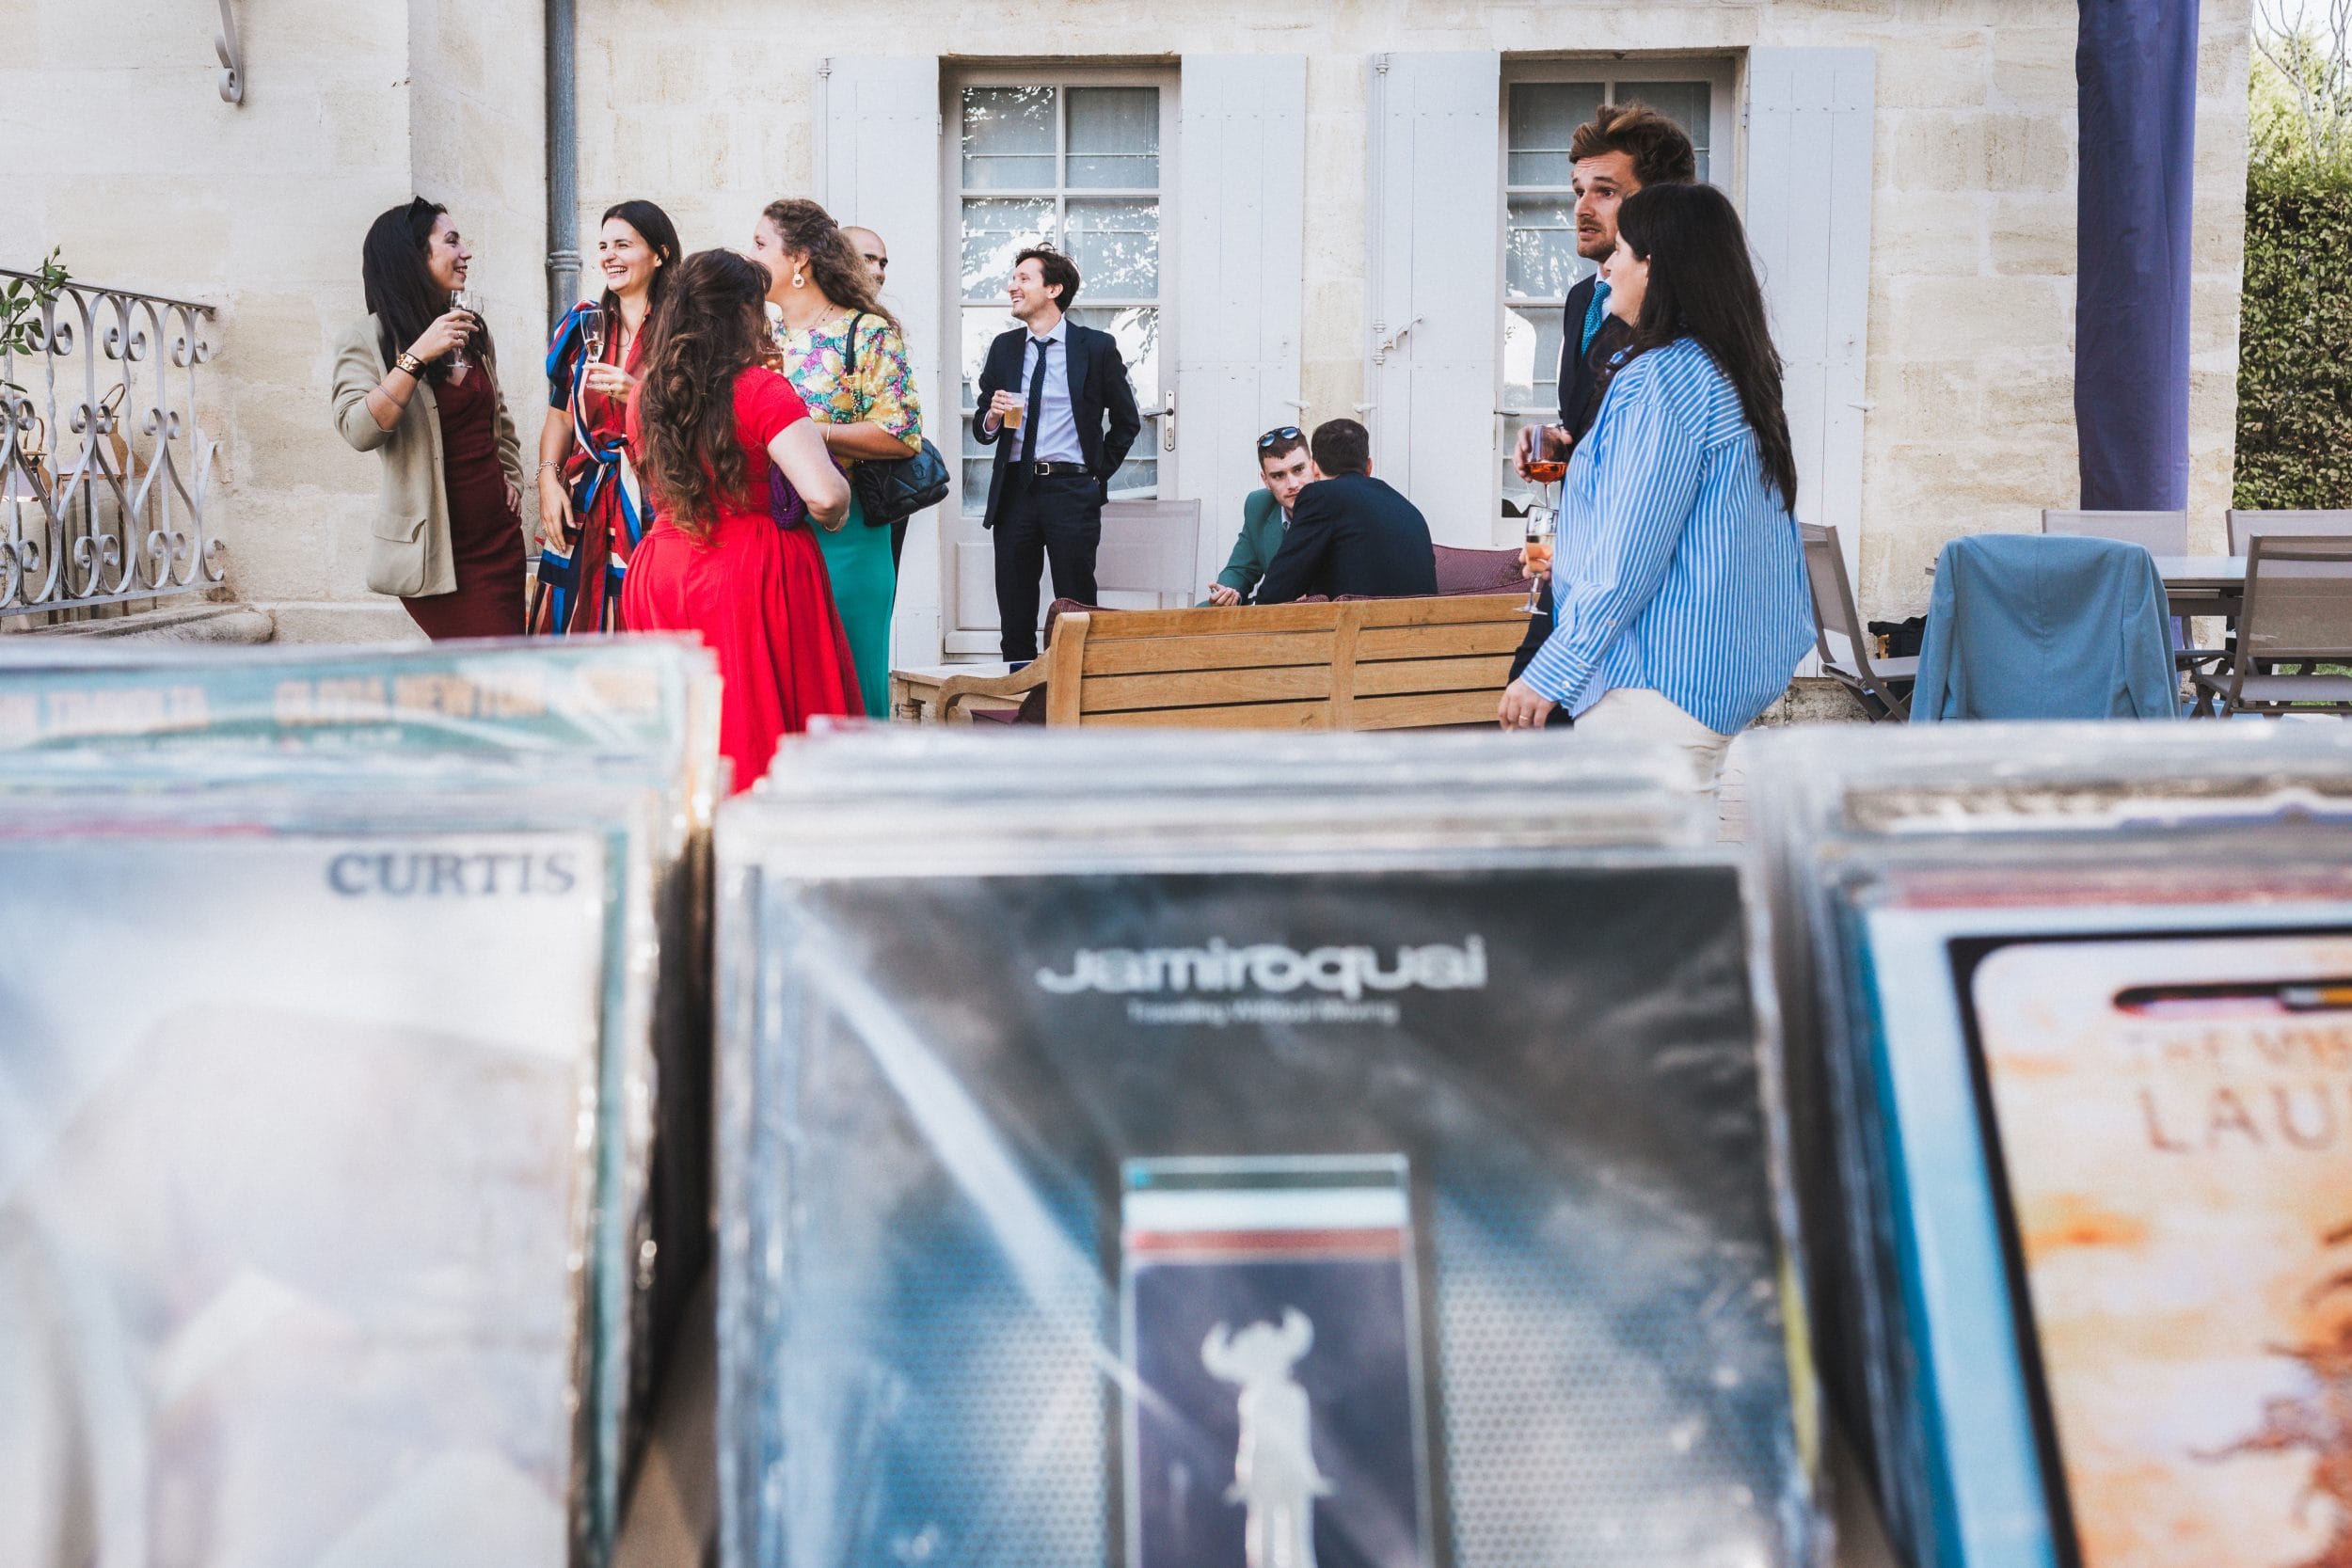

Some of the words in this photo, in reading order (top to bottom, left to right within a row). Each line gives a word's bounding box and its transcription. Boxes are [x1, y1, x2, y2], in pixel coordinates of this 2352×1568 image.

[327, 853, 576, 897] CURTIS
[1037, 935, 1486, 1000] Jamiroquai
[2136, 1081, 2352, 1153] LAU
